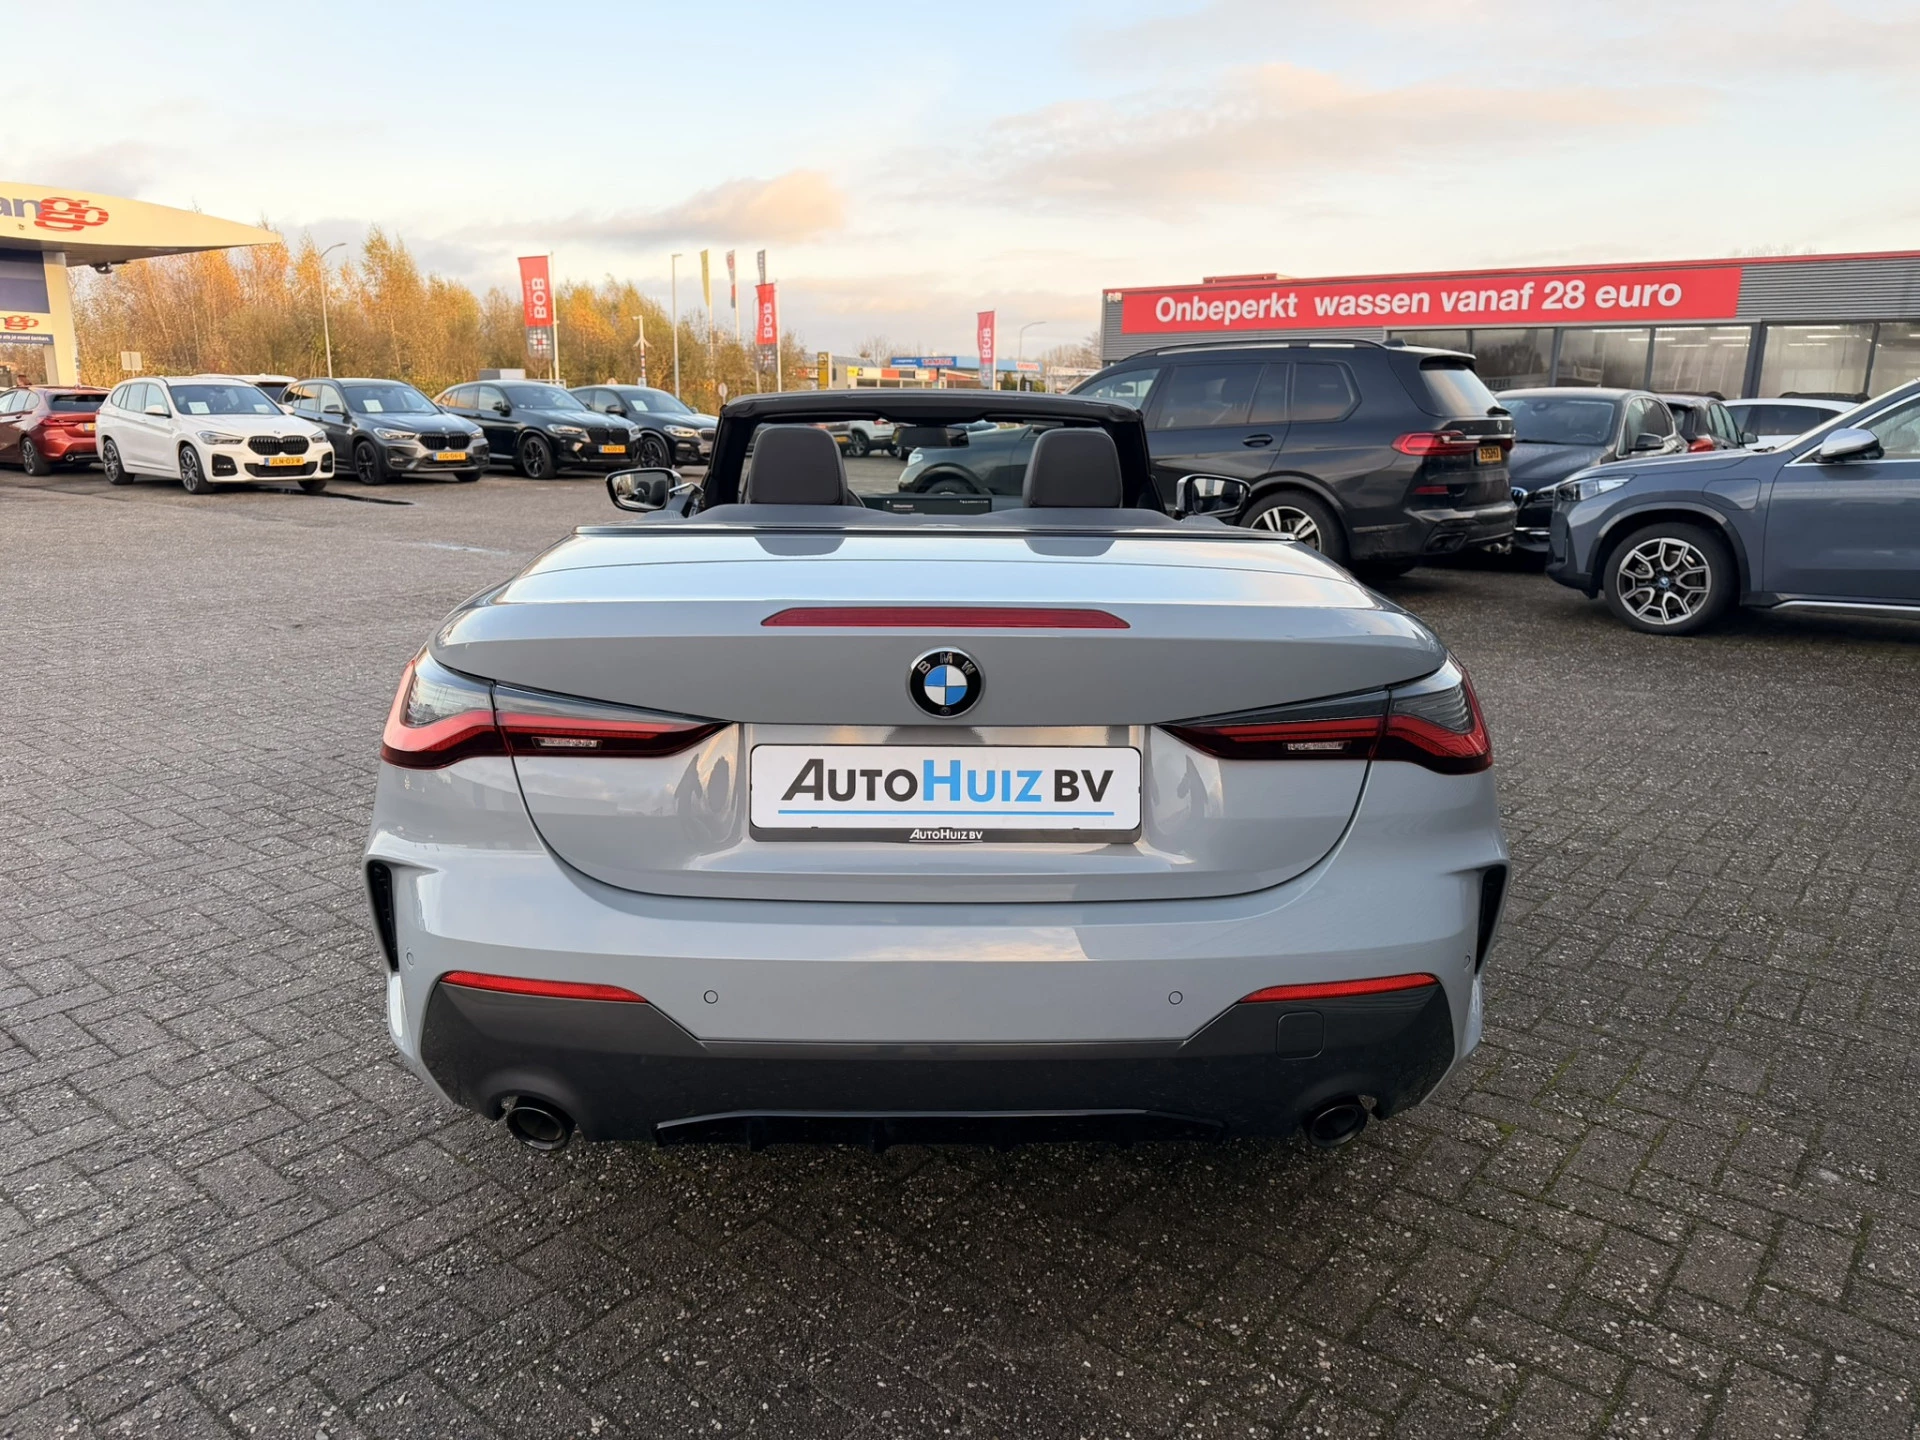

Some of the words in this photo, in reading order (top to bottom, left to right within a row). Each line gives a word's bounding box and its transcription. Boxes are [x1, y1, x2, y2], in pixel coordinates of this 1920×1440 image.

[531, 277, 547, 319] BOB
[1155, 292, 1298, 326] Onbeperkt
[1314, 292, 1430, 317] wassen
[1440, 281, 1535, 313] vanaf
[1541, 279, 1586, 310] 28
[1595, 282, 1682, 309] euro
[763, 302, 773, 338] BOB
[982, 327, 992, 359] BOB
[917, 652, 977, 676] BMW
[1054, 769, 1115, 803] BV
[969, 831, 983, 840] BV
